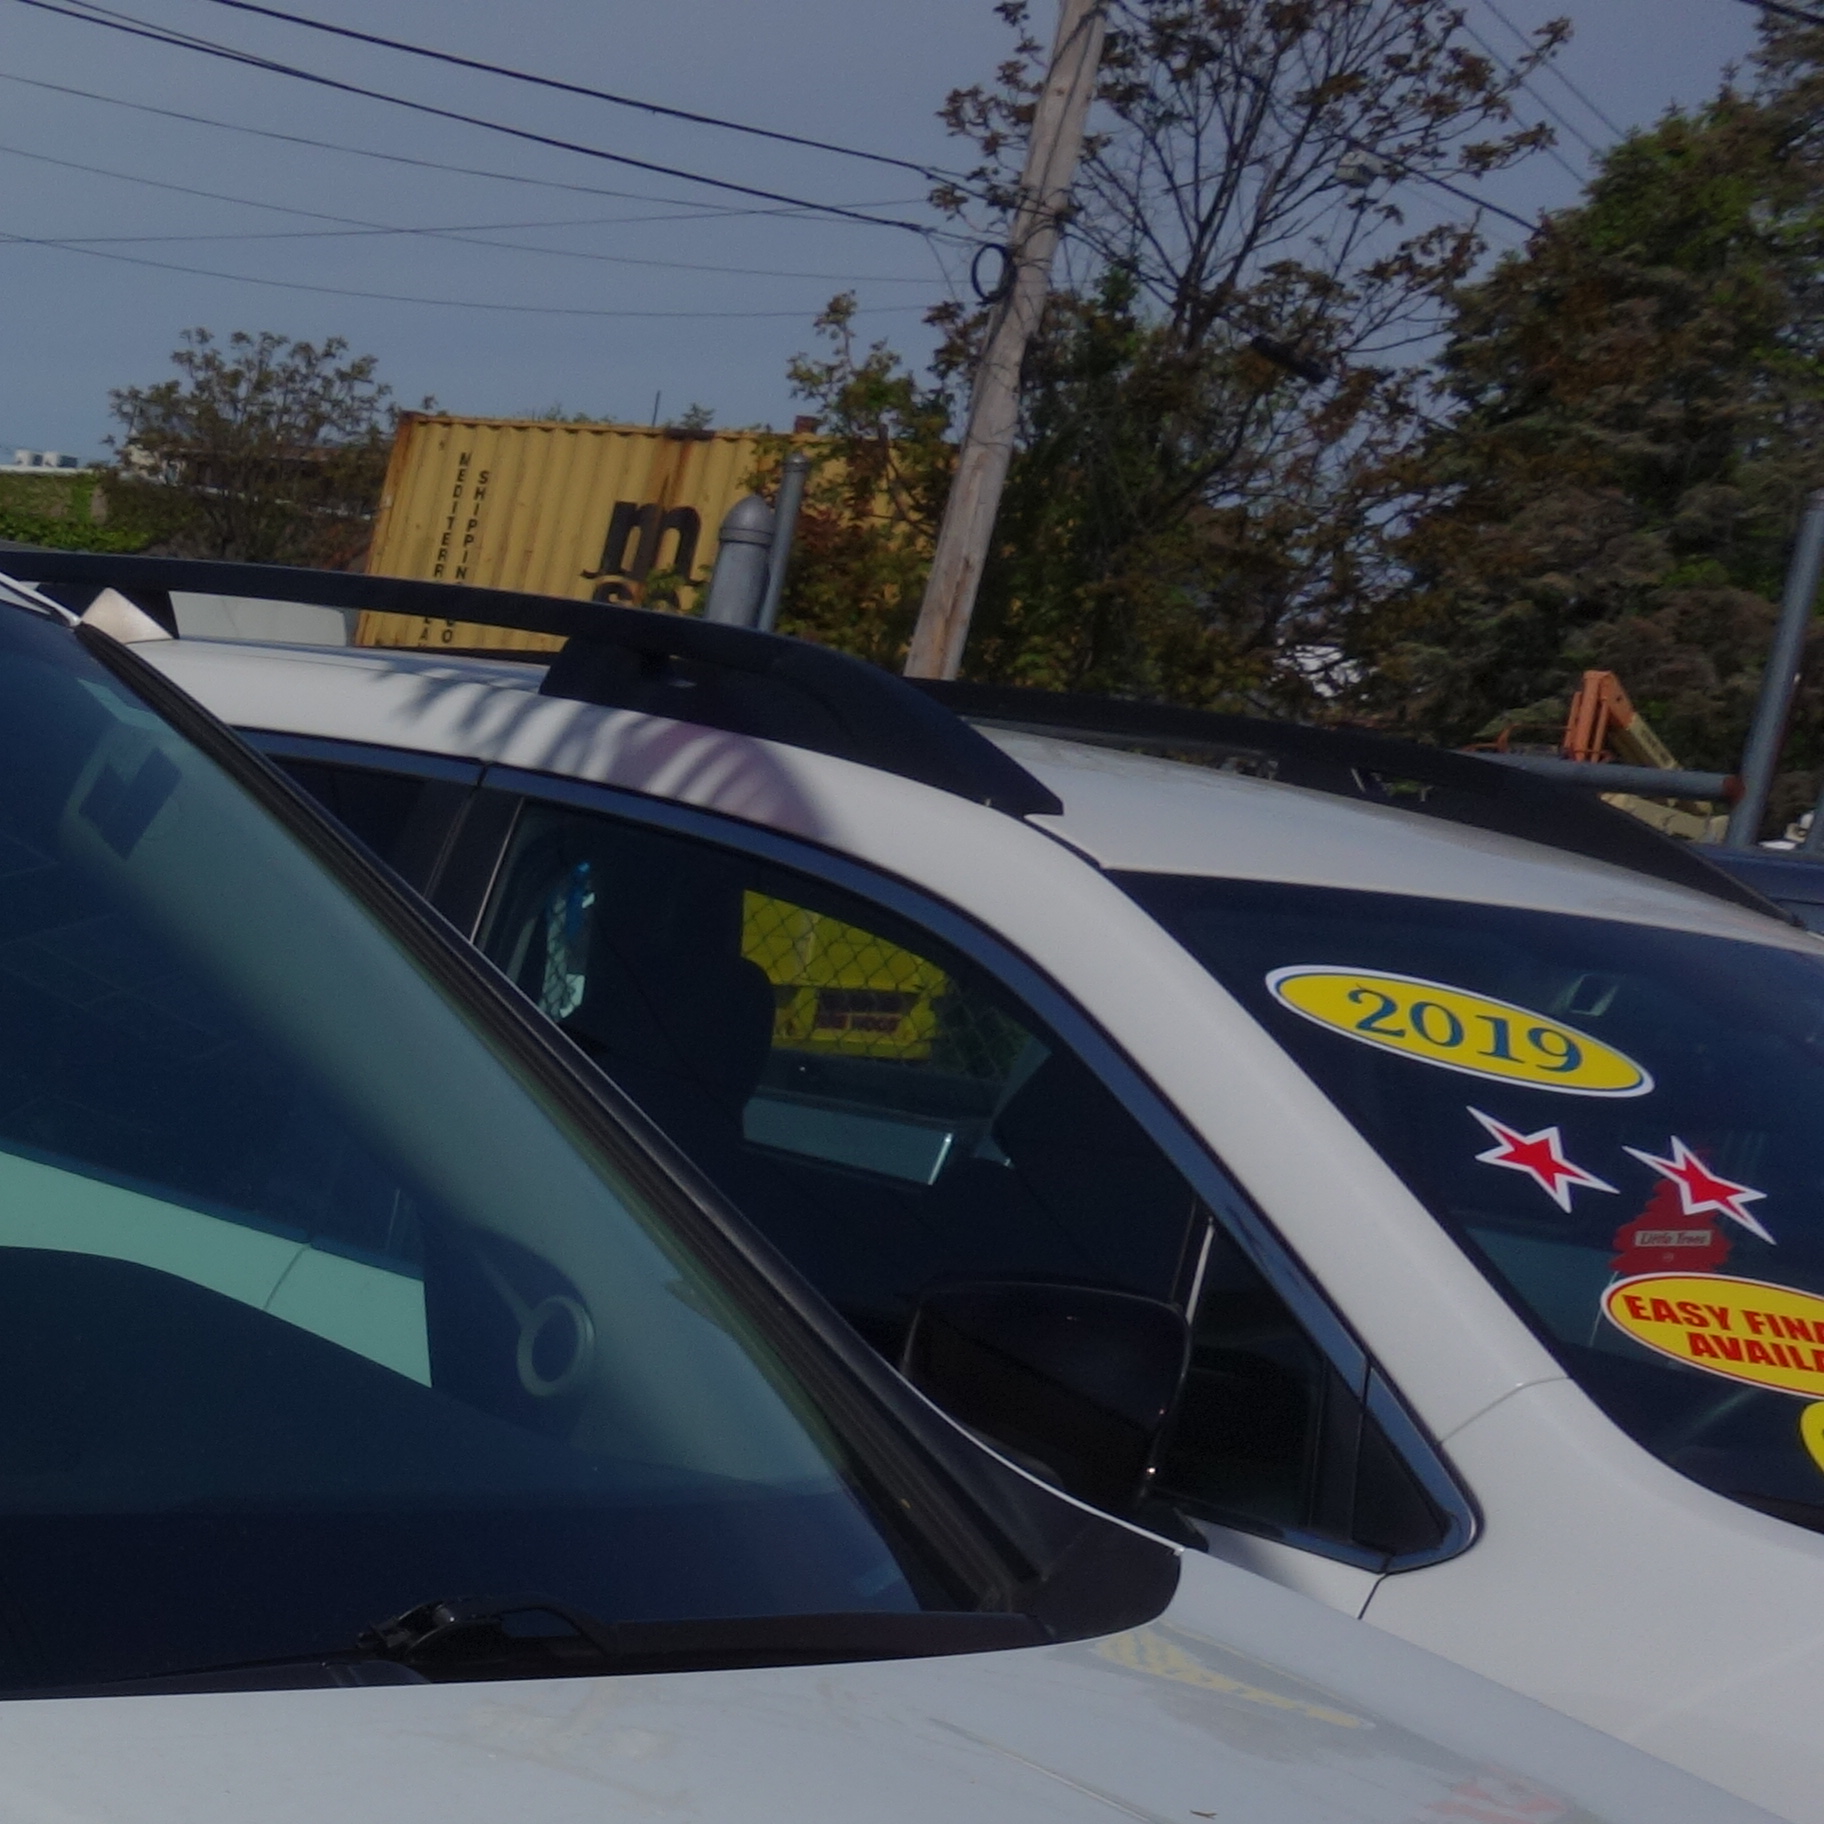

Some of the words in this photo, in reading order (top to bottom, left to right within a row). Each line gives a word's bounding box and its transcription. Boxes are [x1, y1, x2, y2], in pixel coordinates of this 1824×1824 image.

[455, 469, 490, 585] SHIPPIN
[1348, 988, 1583, 1073] 2019
[1623, 1294, 1731, 1331] EASY
